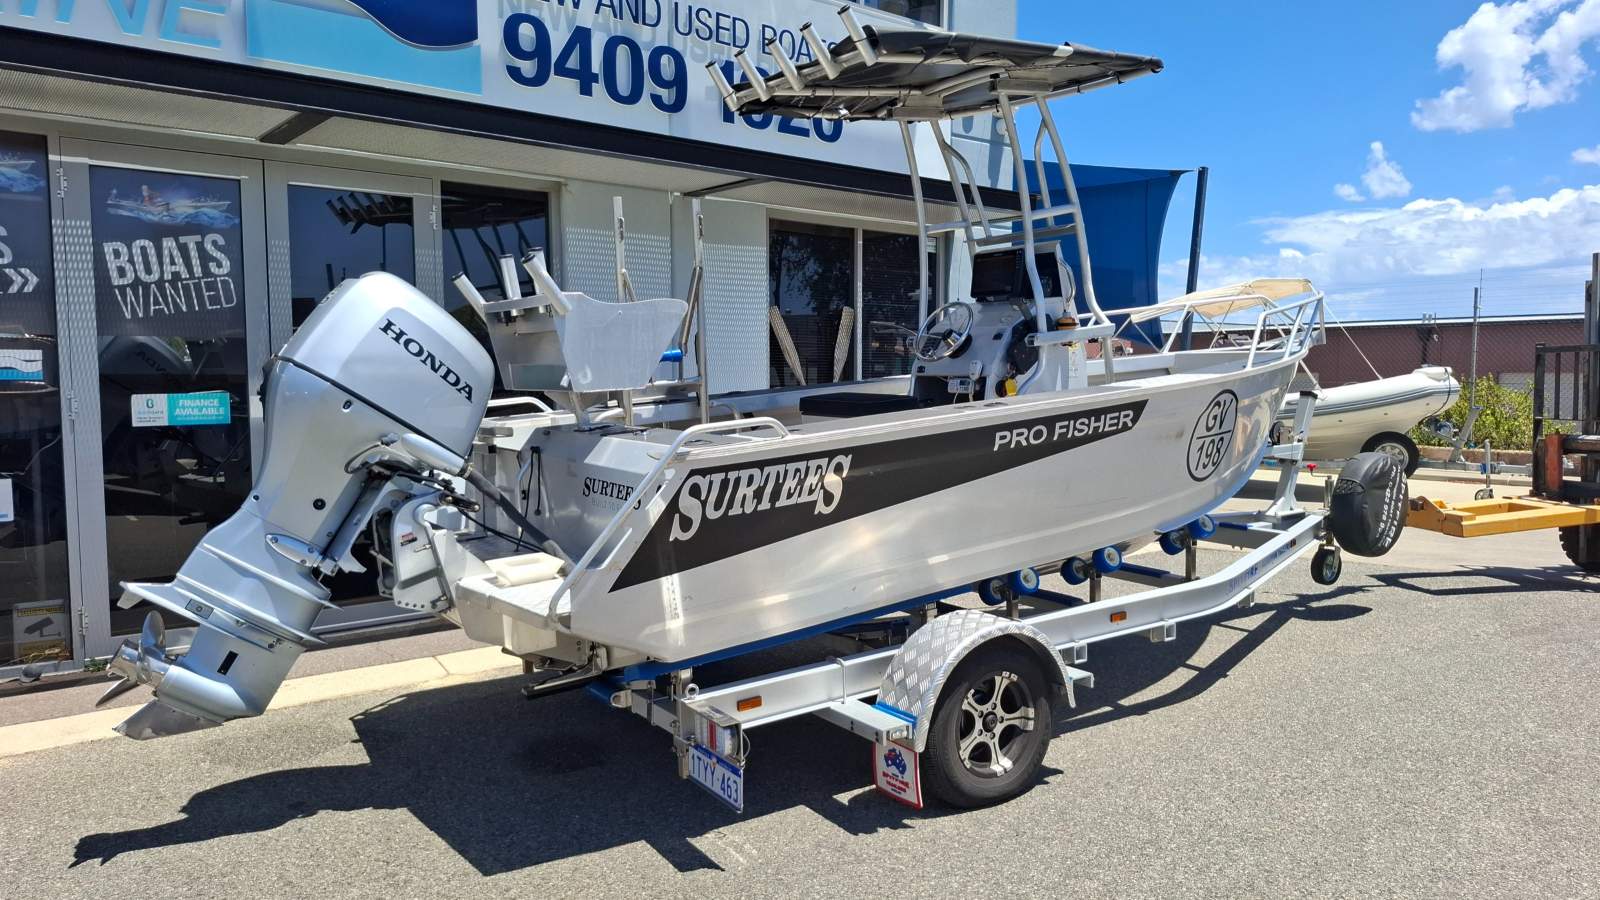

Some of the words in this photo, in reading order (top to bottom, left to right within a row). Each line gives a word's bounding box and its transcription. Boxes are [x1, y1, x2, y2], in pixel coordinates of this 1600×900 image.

[674, 1, 750, 49] USED
[503, 12, 688, 114] 9409
[103, 233, 231, 286] BOATS
[114, 276, 237, 319] WANTED
[379, 319, 473, 404] HONDA
[175, 408, 225, 416] AVAILABLE
[179, 399, 220, 408] FINANCE
[1205, 398, 1234, 433] GV
[993, 425, 1048, 452] PRO
[1053, 410, 1134, 441] FISHER
[1195, 436, 1225, 471] 198
[669, 454, 853, 542] SURTEES
